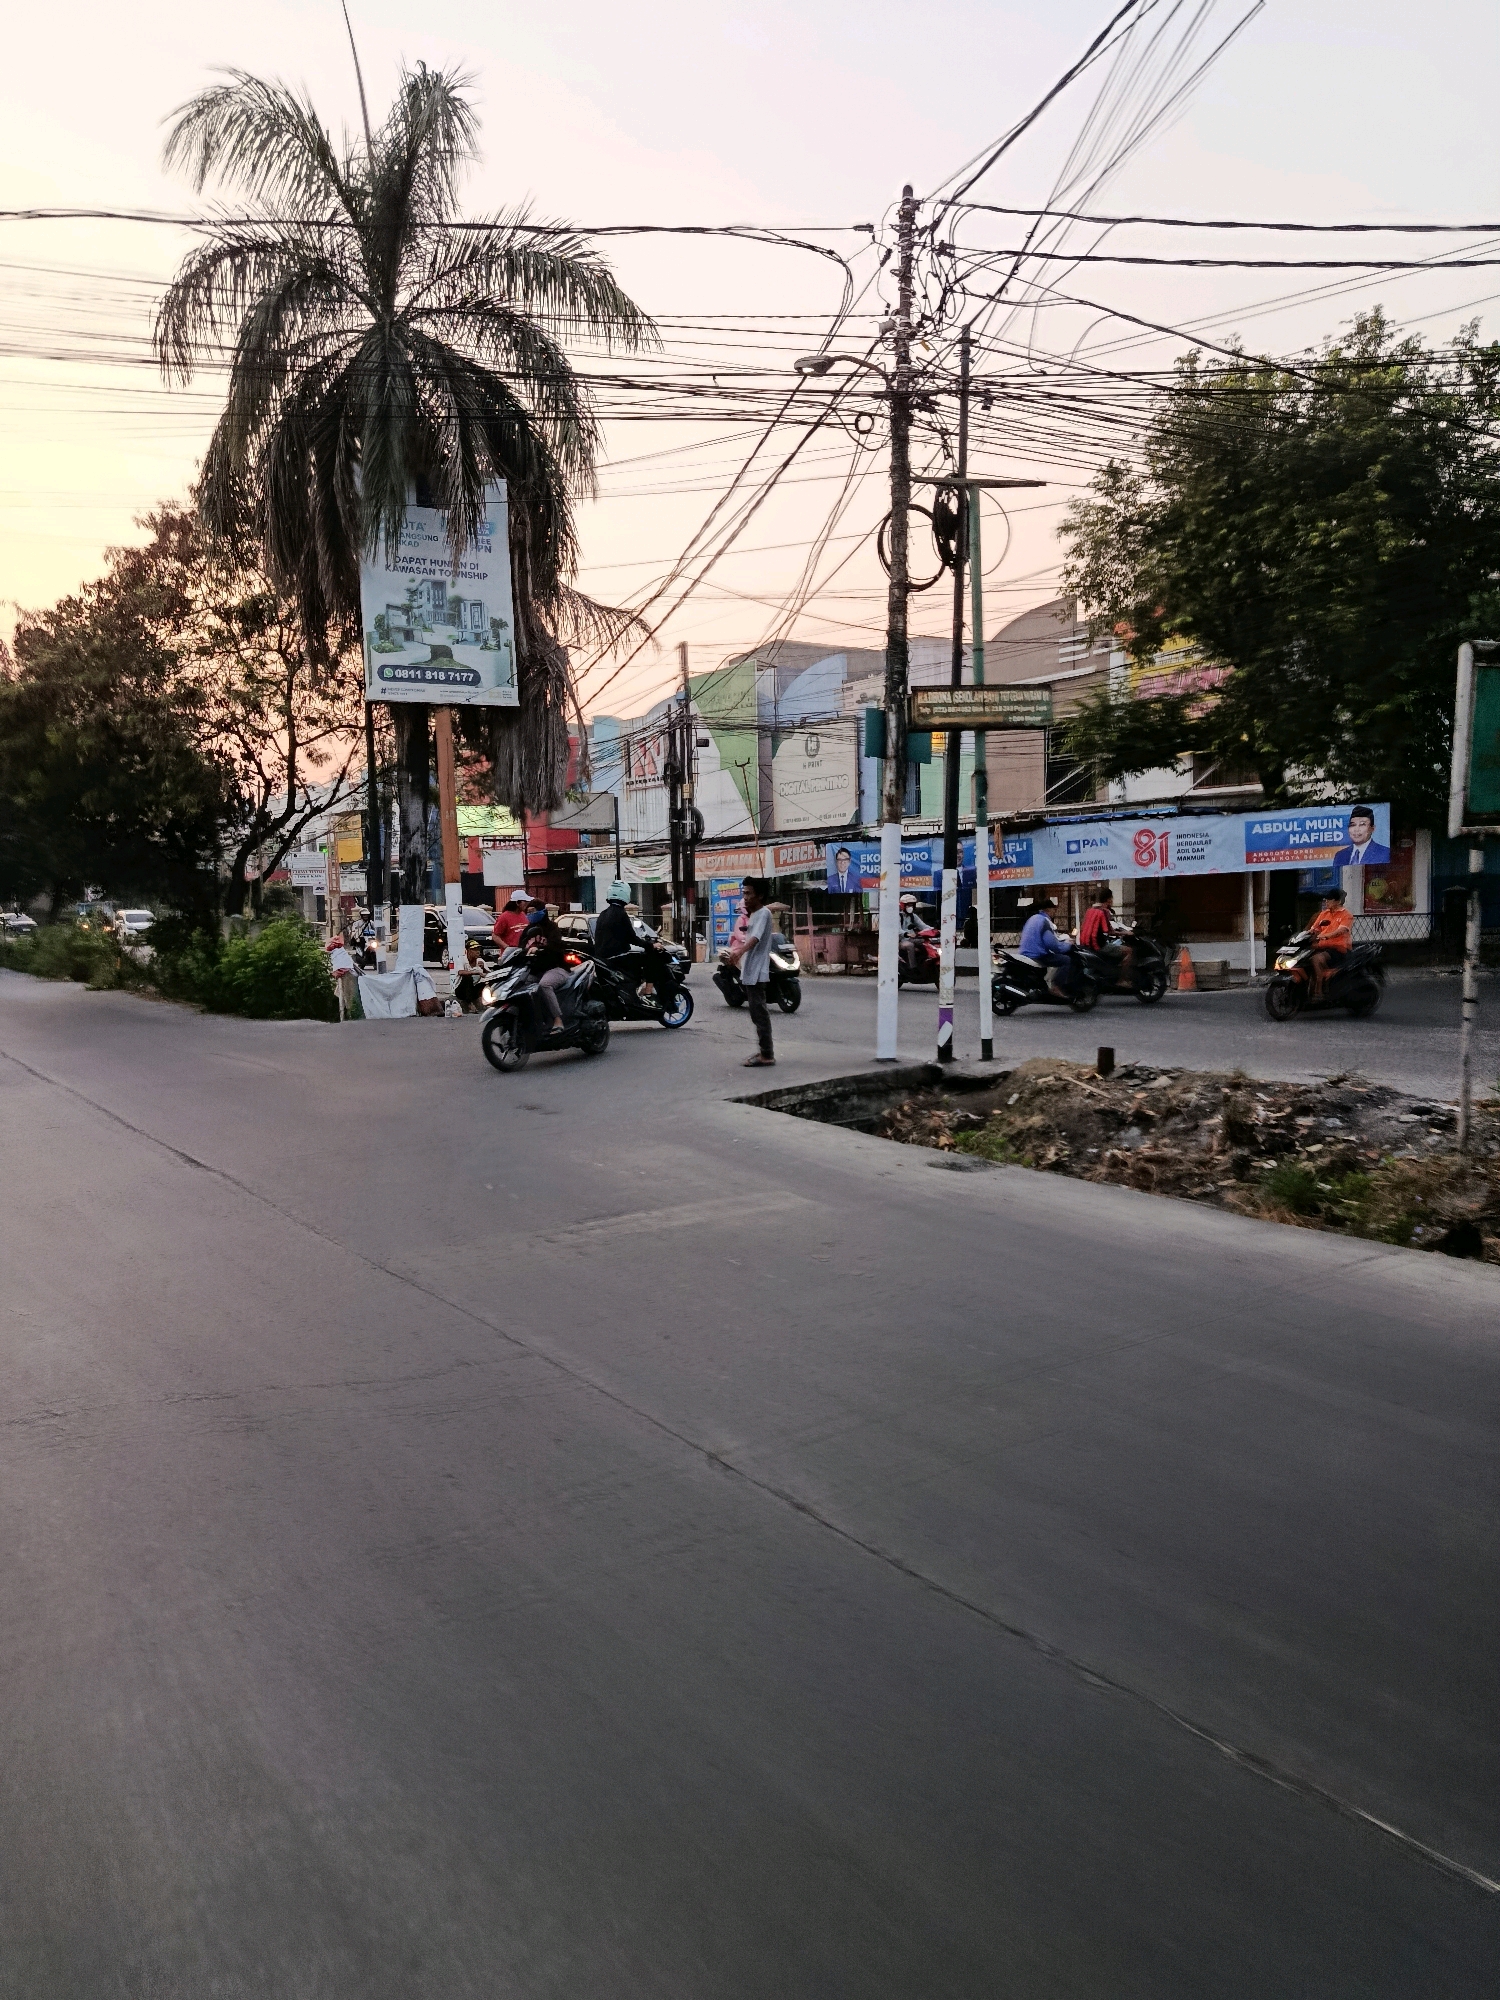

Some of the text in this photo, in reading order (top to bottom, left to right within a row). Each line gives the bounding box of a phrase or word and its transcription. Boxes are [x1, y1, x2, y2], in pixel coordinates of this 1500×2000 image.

[399, 532, 439, 543] ANGSUNG
[395, 556, 479, 571] DAPAT HUNIN DI
[384, 562, 489, 581] KAWASAN TONSHIP
[395, 669, 474, 682] 0811 818 7177
[780, 774, 849, 797] DIGITAL PRINTING
[1252, 818, 1343, 834] ABDUL MUIN
[1082, 837, 1109, 848] PAN
[1176, 832, 1209, 840] INDONESIA
[1289, 831, 1344, 845] HAFIED
[1177, 839, 1212, 847] BERDAULAT
[1134, 829, 1171, 871] 81
[860, 853, 881, 863] EKO
